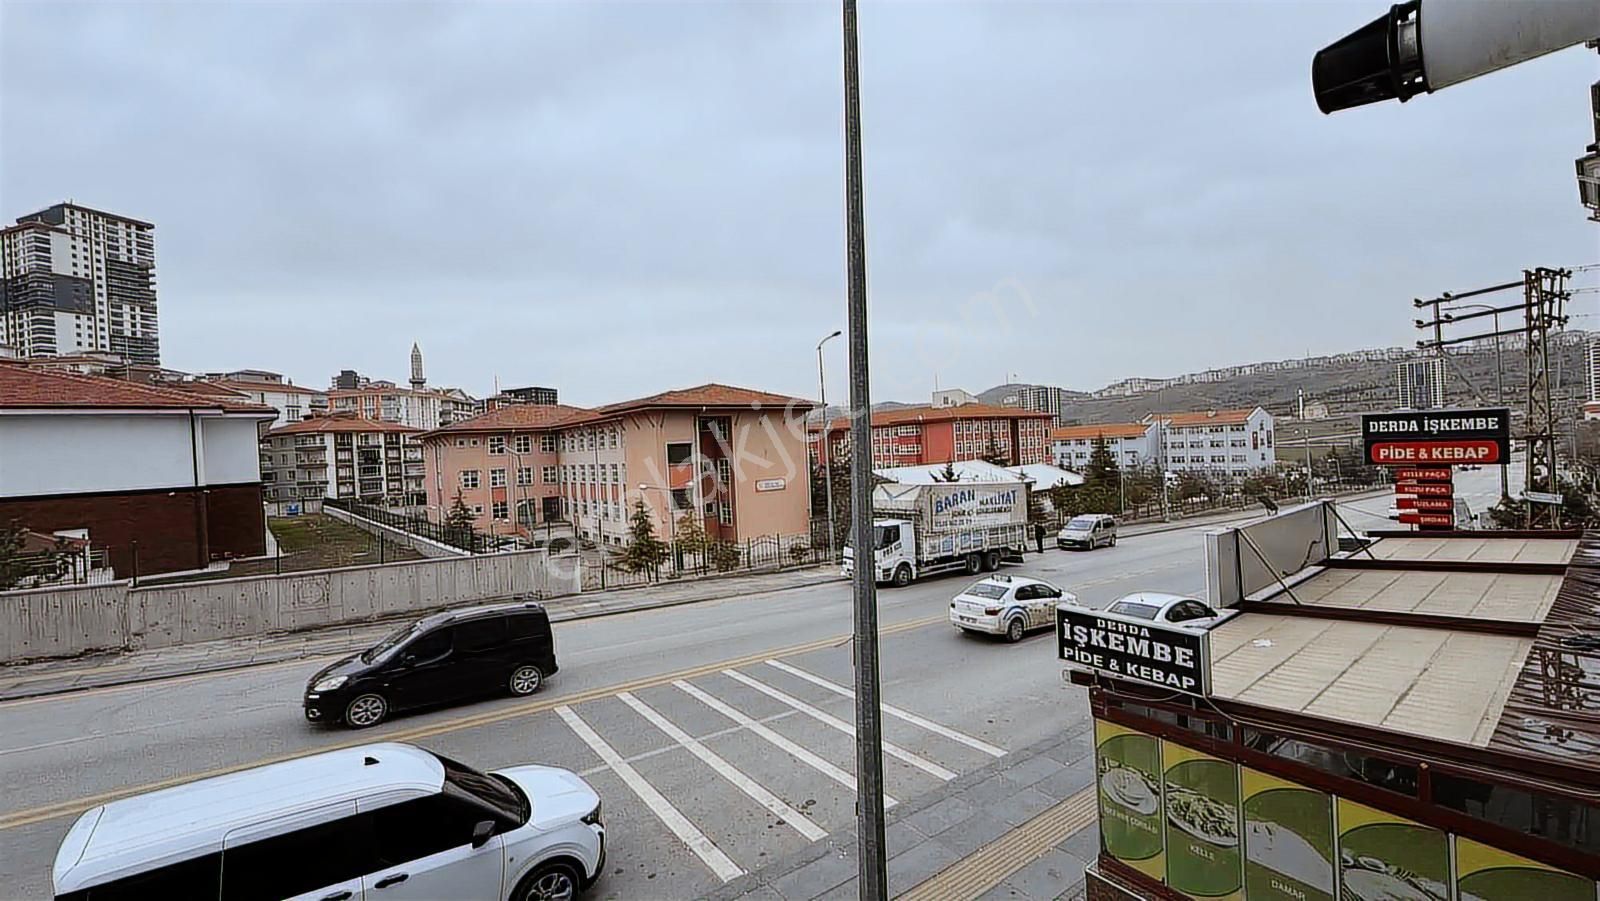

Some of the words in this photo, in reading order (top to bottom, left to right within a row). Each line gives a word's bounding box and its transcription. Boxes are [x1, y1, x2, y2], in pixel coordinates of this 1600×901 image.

[1369, 420, 1419, 433] DERDA
[1424, 416, 1499, 435] İŞKEMBE
[1379, 446, 1416, 459] PİDE
[1418, 449, 1428, 459] &
[1432, 446, 1489, 459] KEBAP
[1425, 471, 1447, 479] PAÇA
[935, 489, 976, 513] BARAN
[1097, 618, 1150, 638] DERDA
[1063, 618, 1195, 669] İŞKEMBE
[1063, 646, 1104, 667] PİDE
[1109, 658, 1121, 672] &
[1126, 662, 1196, 689] KEBAP
